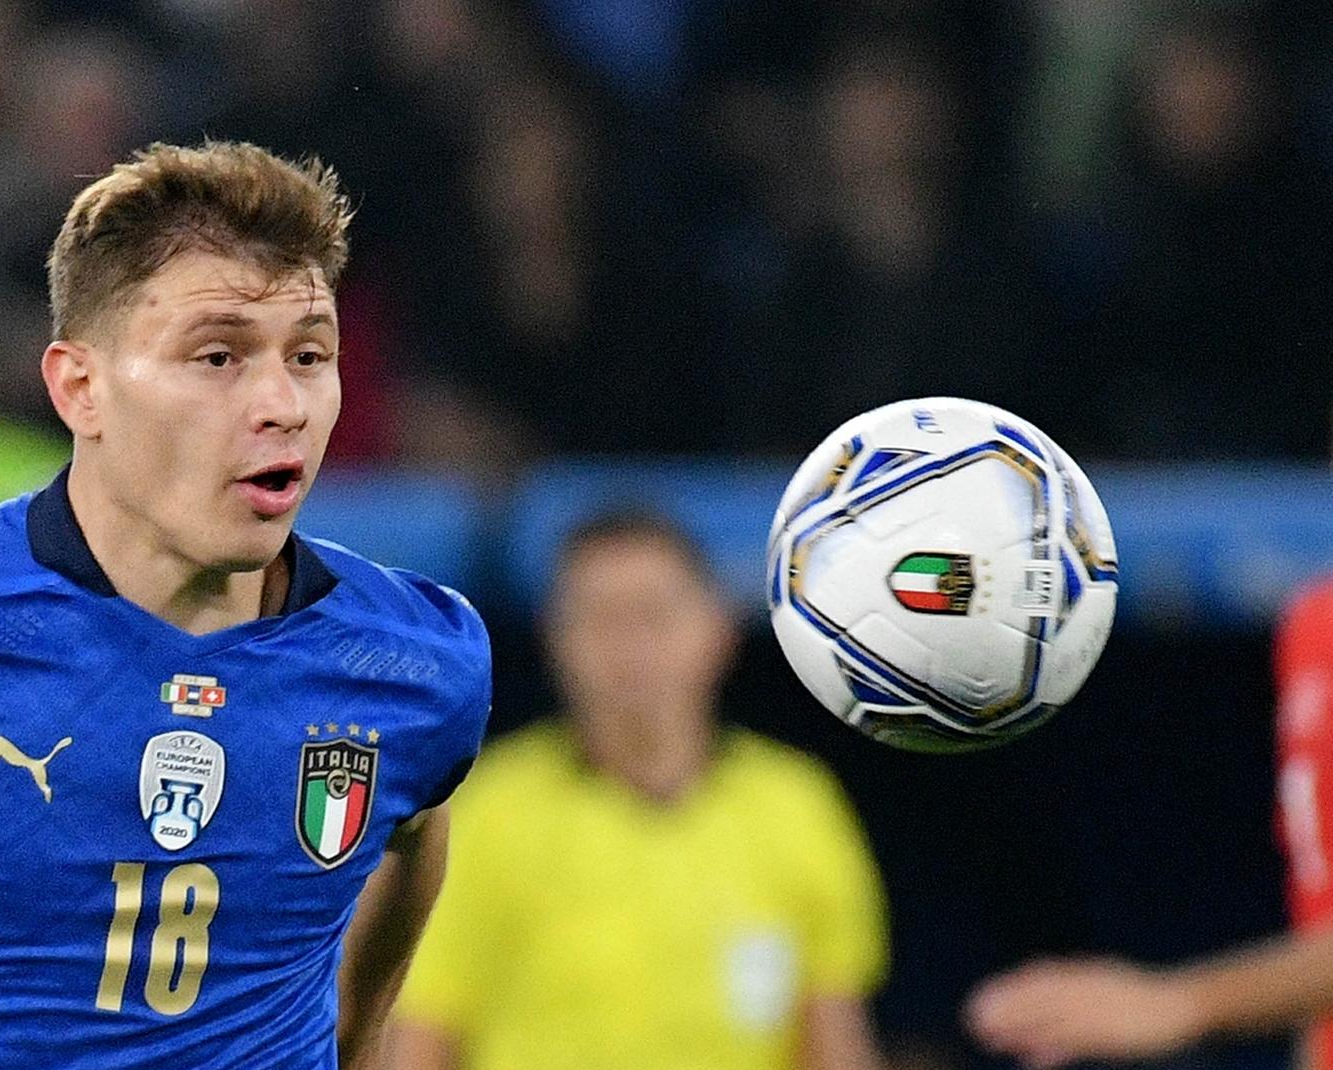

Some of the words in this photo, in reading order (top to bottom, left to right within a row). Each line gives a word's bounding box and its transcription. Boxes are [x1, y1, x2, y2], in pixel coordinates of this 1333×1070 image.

[156, 752, 213, 767] EUROPEAN
[308, 749, 370, 774] ITALIA
[156, 762, 212, 777] CHAMPIONS
[159, 825, 188, 839] 2020
[95, 862, 220, 1016] 18
